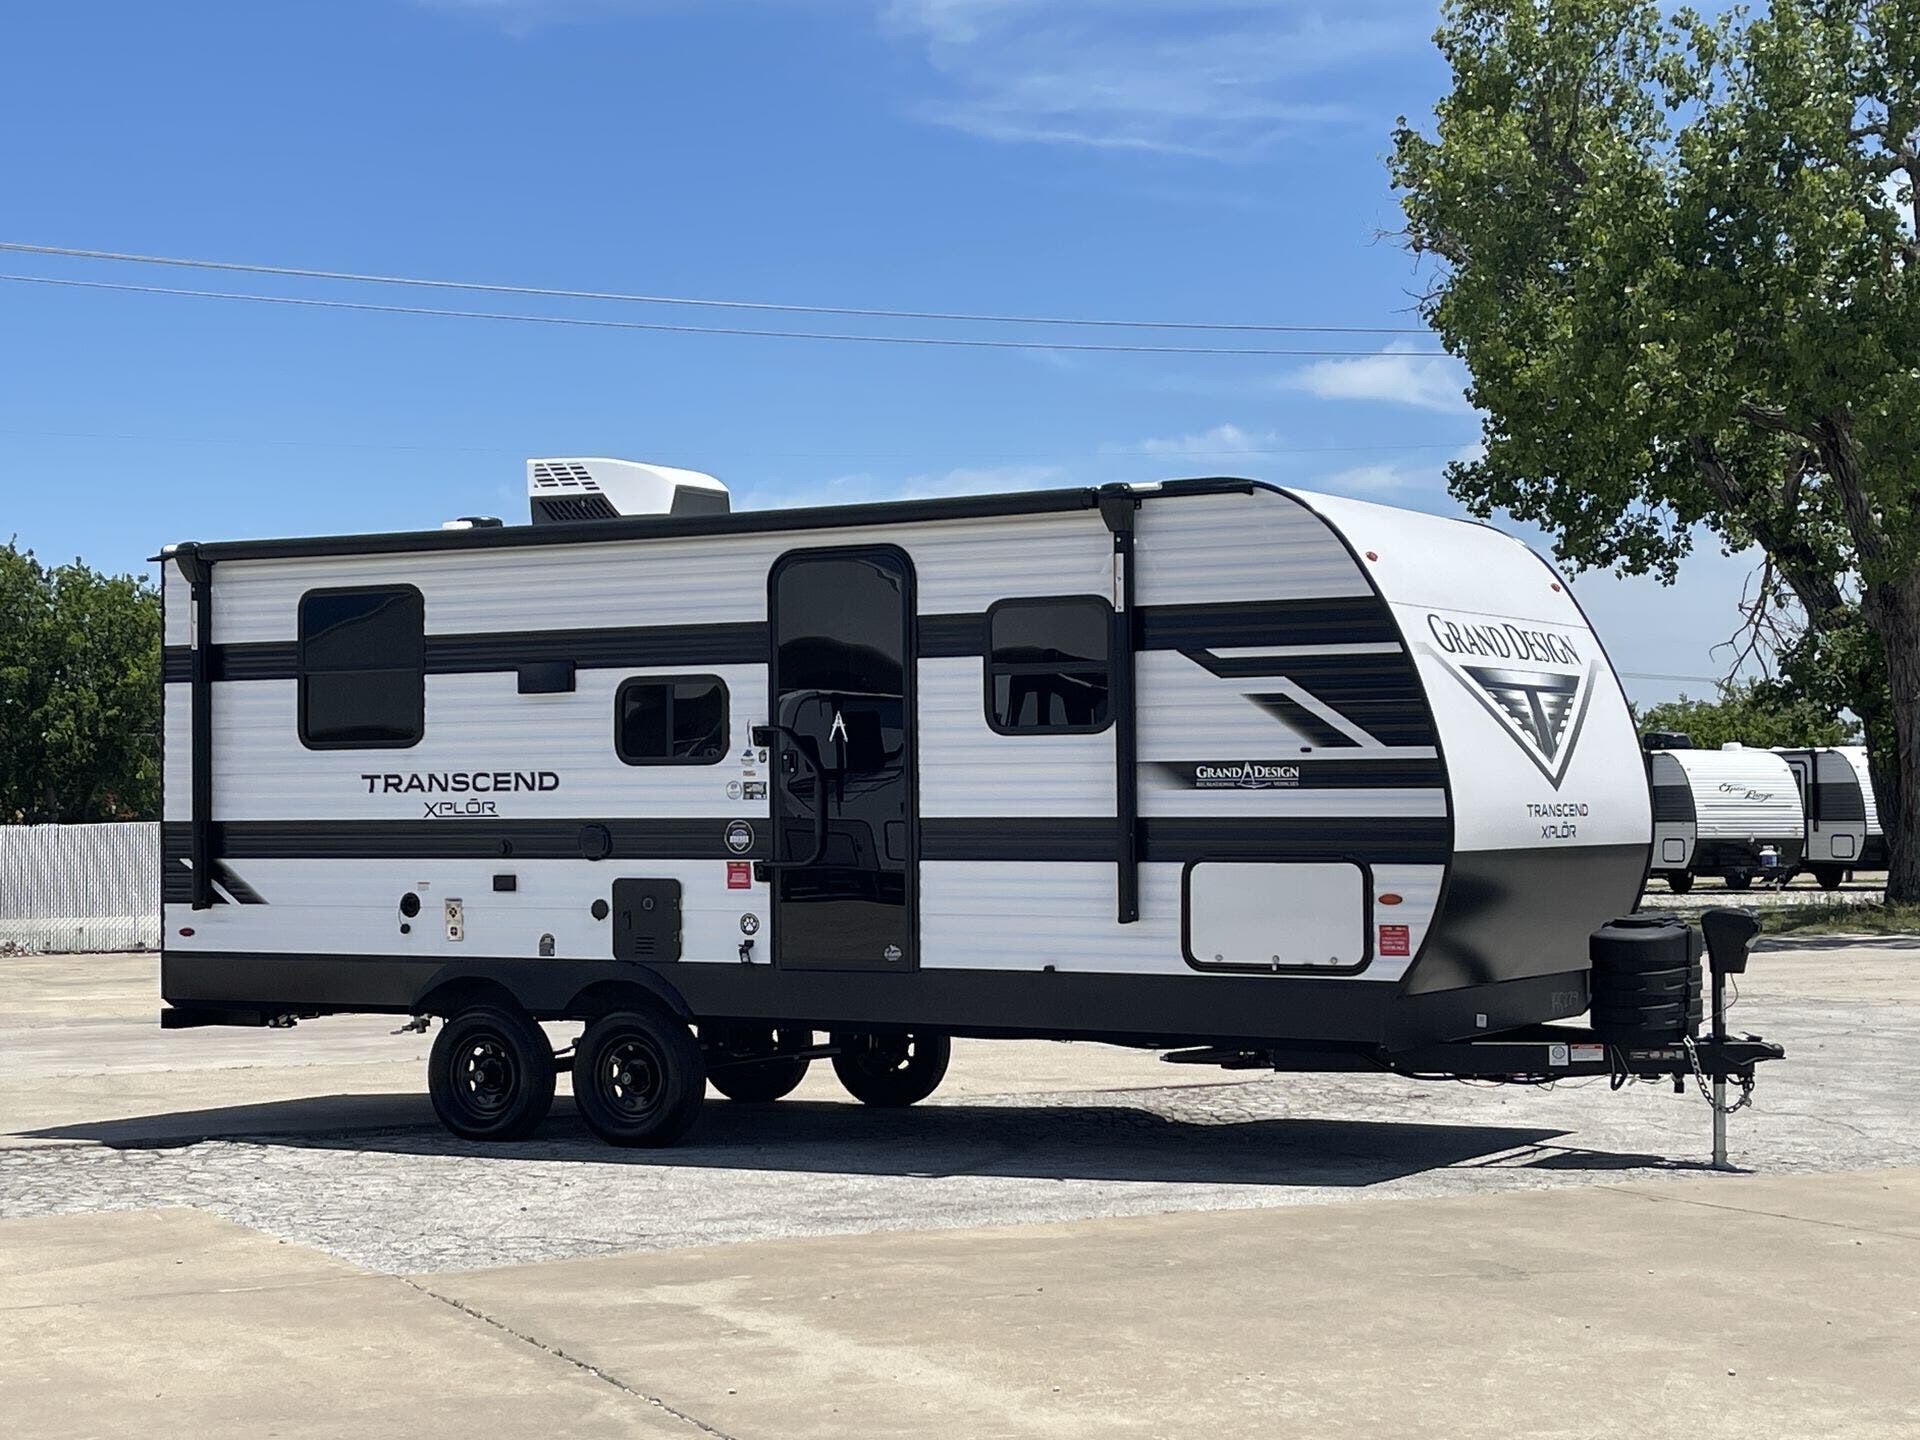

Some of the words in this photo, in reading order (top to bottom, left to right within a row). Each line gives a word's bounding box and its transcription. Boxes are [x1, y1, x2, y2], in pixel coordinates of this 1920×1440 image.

[1427, 613, 1511, 658] GRAND
[1499, 622, 1583, 665] DESIGN
[1196, 765, 1242, 778] GRAND
[1253, 765, 1299, 778] DESIGN
[361, 771, 560, 793] TRANSCEND
[1526, 803, 1588, 817] TRANSCEND
